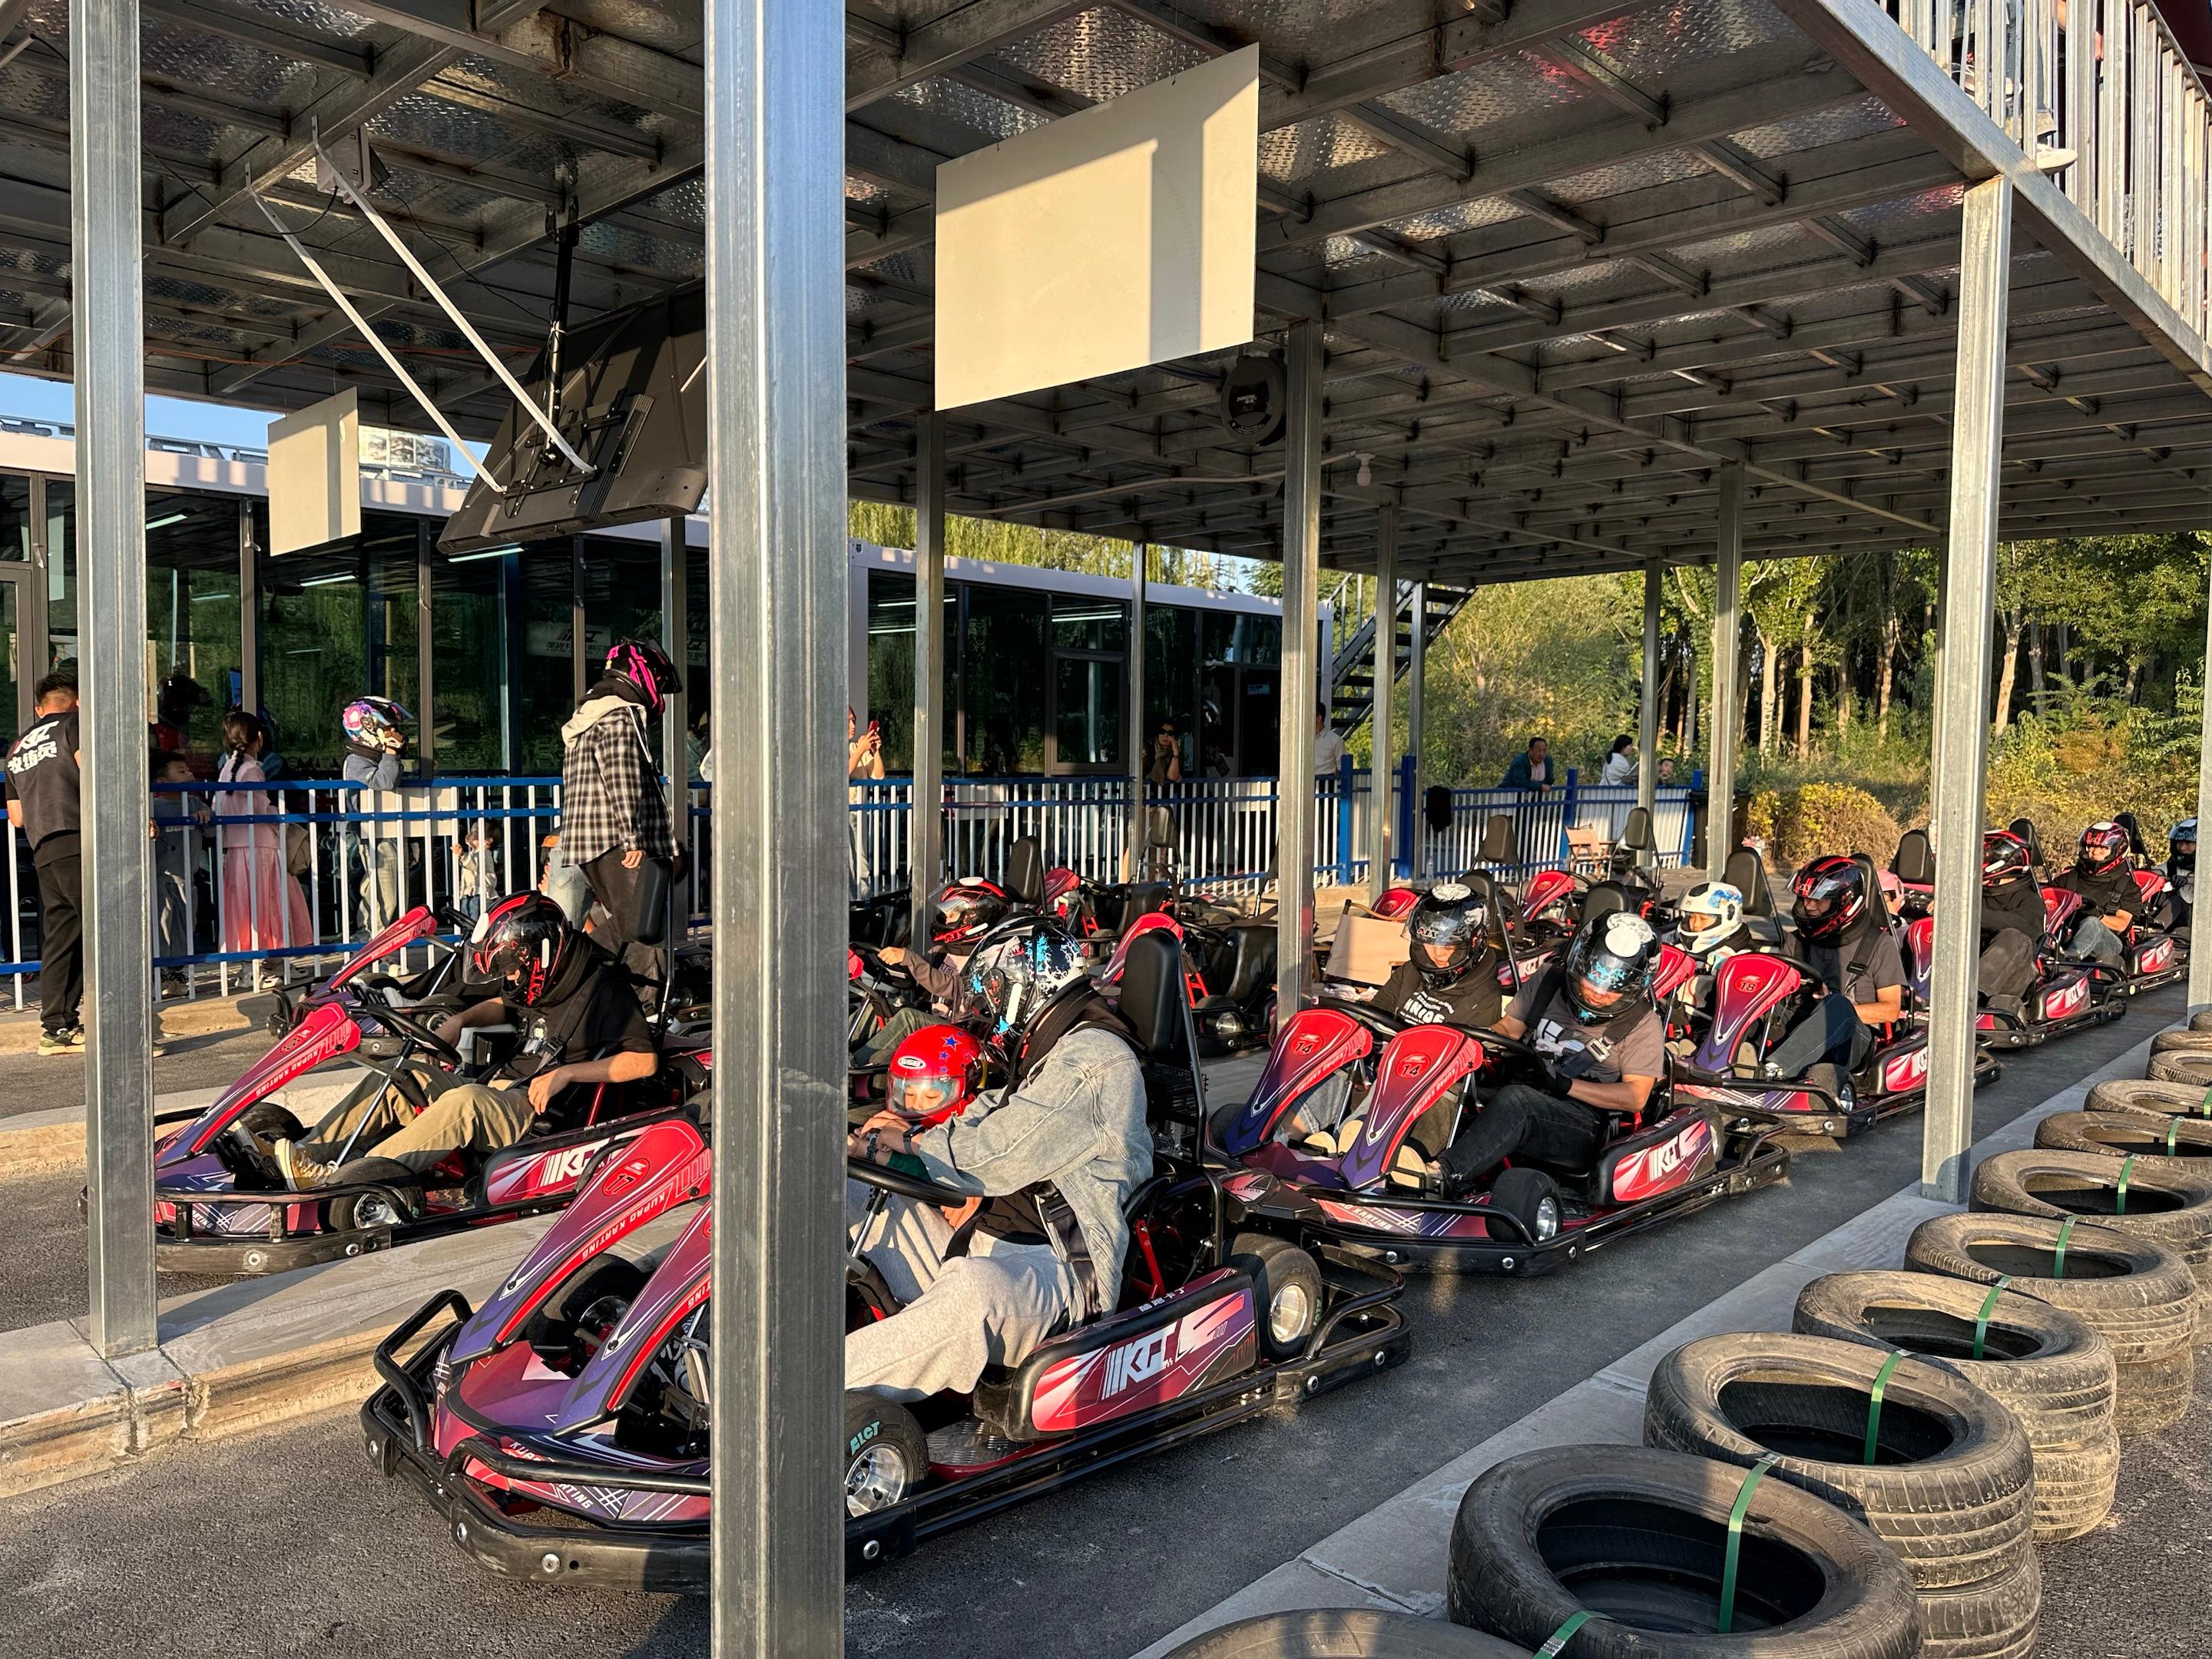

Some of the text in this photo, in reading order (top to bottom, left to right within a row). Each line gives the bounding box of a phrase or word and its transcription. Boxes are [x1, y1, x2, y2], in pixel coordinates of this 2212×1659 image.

[1739, 982, 1756, 992] 18
[1295, 1041, 1314, 1053] 14
[255, 1049, 319, 1097] KUPAO KARTING
[1402, 1064, 1421, 1076] 14
[607, 1173, 635, 1194] 17
[581, 1191, 666, 1260] KUPAO KARTING
[1353, 1208, 1394, 1230] KARTING
